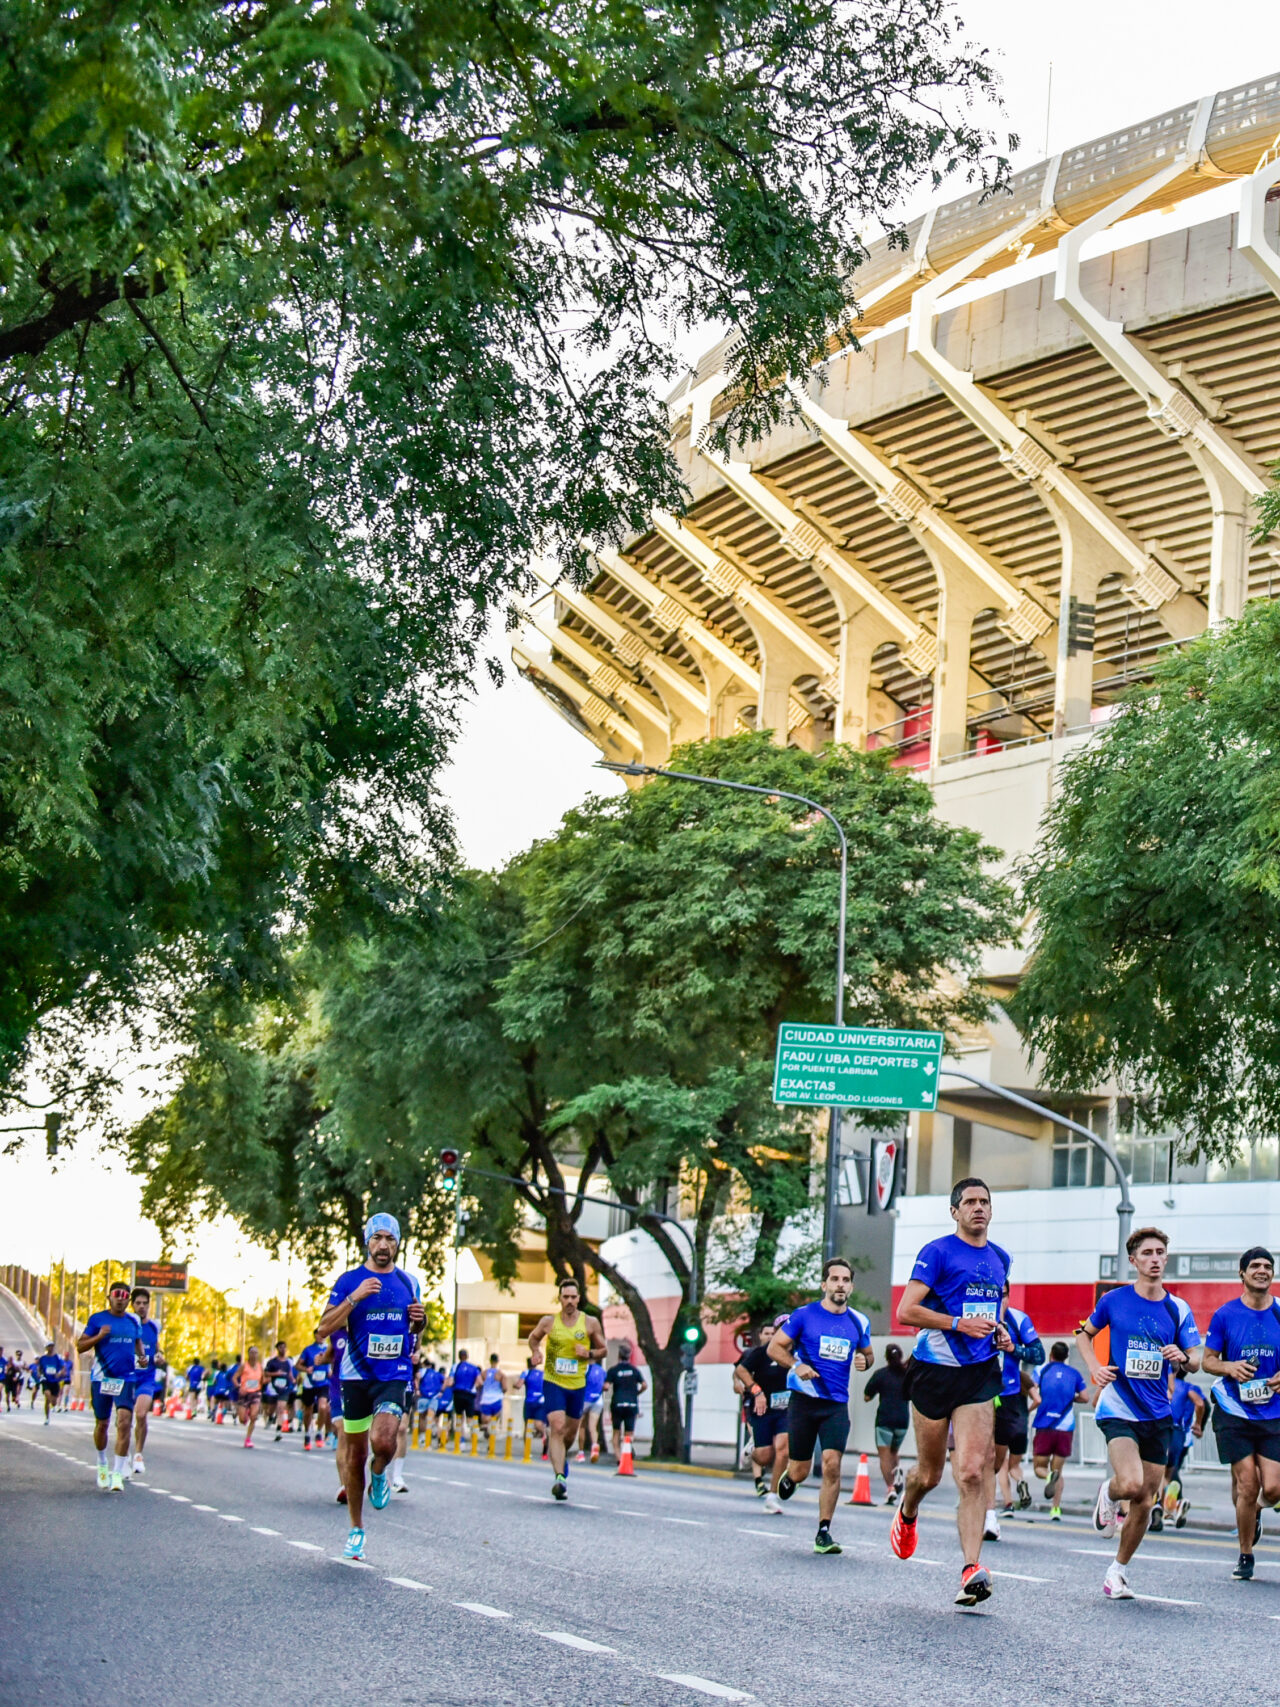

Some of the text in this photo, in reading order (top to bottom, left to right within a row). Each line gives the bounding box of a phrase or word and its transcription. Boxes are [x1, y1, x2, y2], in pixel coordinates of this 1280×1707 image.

[785, 1030, 937, 1049] CIUDAD UNIVERSITARIA
[783, 1051, 919, 1068] FADU / UBA DEPORTES
[782, 1064, 878, 1076] POR PUENTE LABRUNA
[780, 1078, 836, 1091] EXACTAS
[779, 1091, 903, 1105] POR AV. LEOPOLDO LUGONES
[387, 1313, 403, 1321] RUN
[371, 1342, 399, 1353] 1644
[825, 1343, 844, 1355] 429
[1260, 1348, 1275, 1357] RUN
[1130, 1359, 1160, 1372] 1620
[1246, 1387, 1270, 1399] 804
